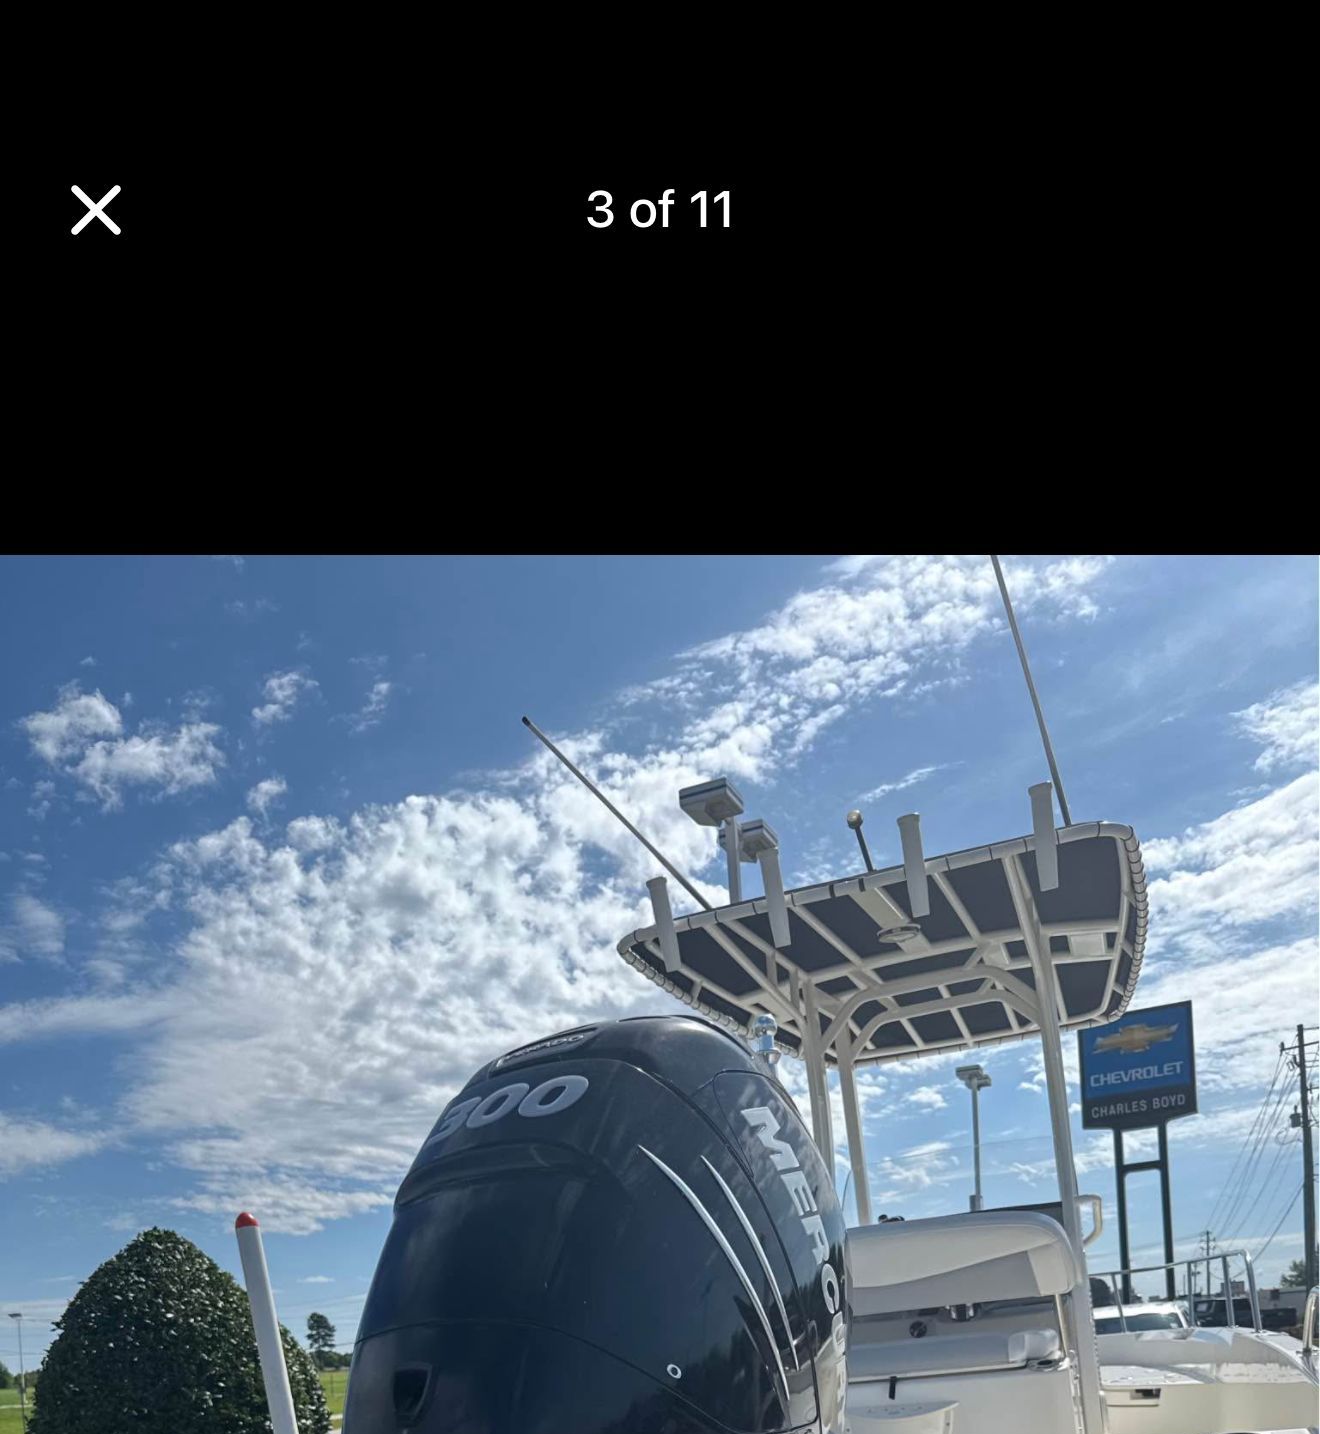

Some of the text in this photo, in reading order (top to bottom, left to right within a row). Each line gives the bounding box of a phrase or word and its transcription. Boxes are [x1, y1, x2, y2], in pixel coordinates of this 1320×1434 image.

[1090, 1061, 1184, 1087] CHEVROLET
[421, 1074, 590, 1149] 300
[1091, 1093, 1186, 1119] CHARLES BOYD
